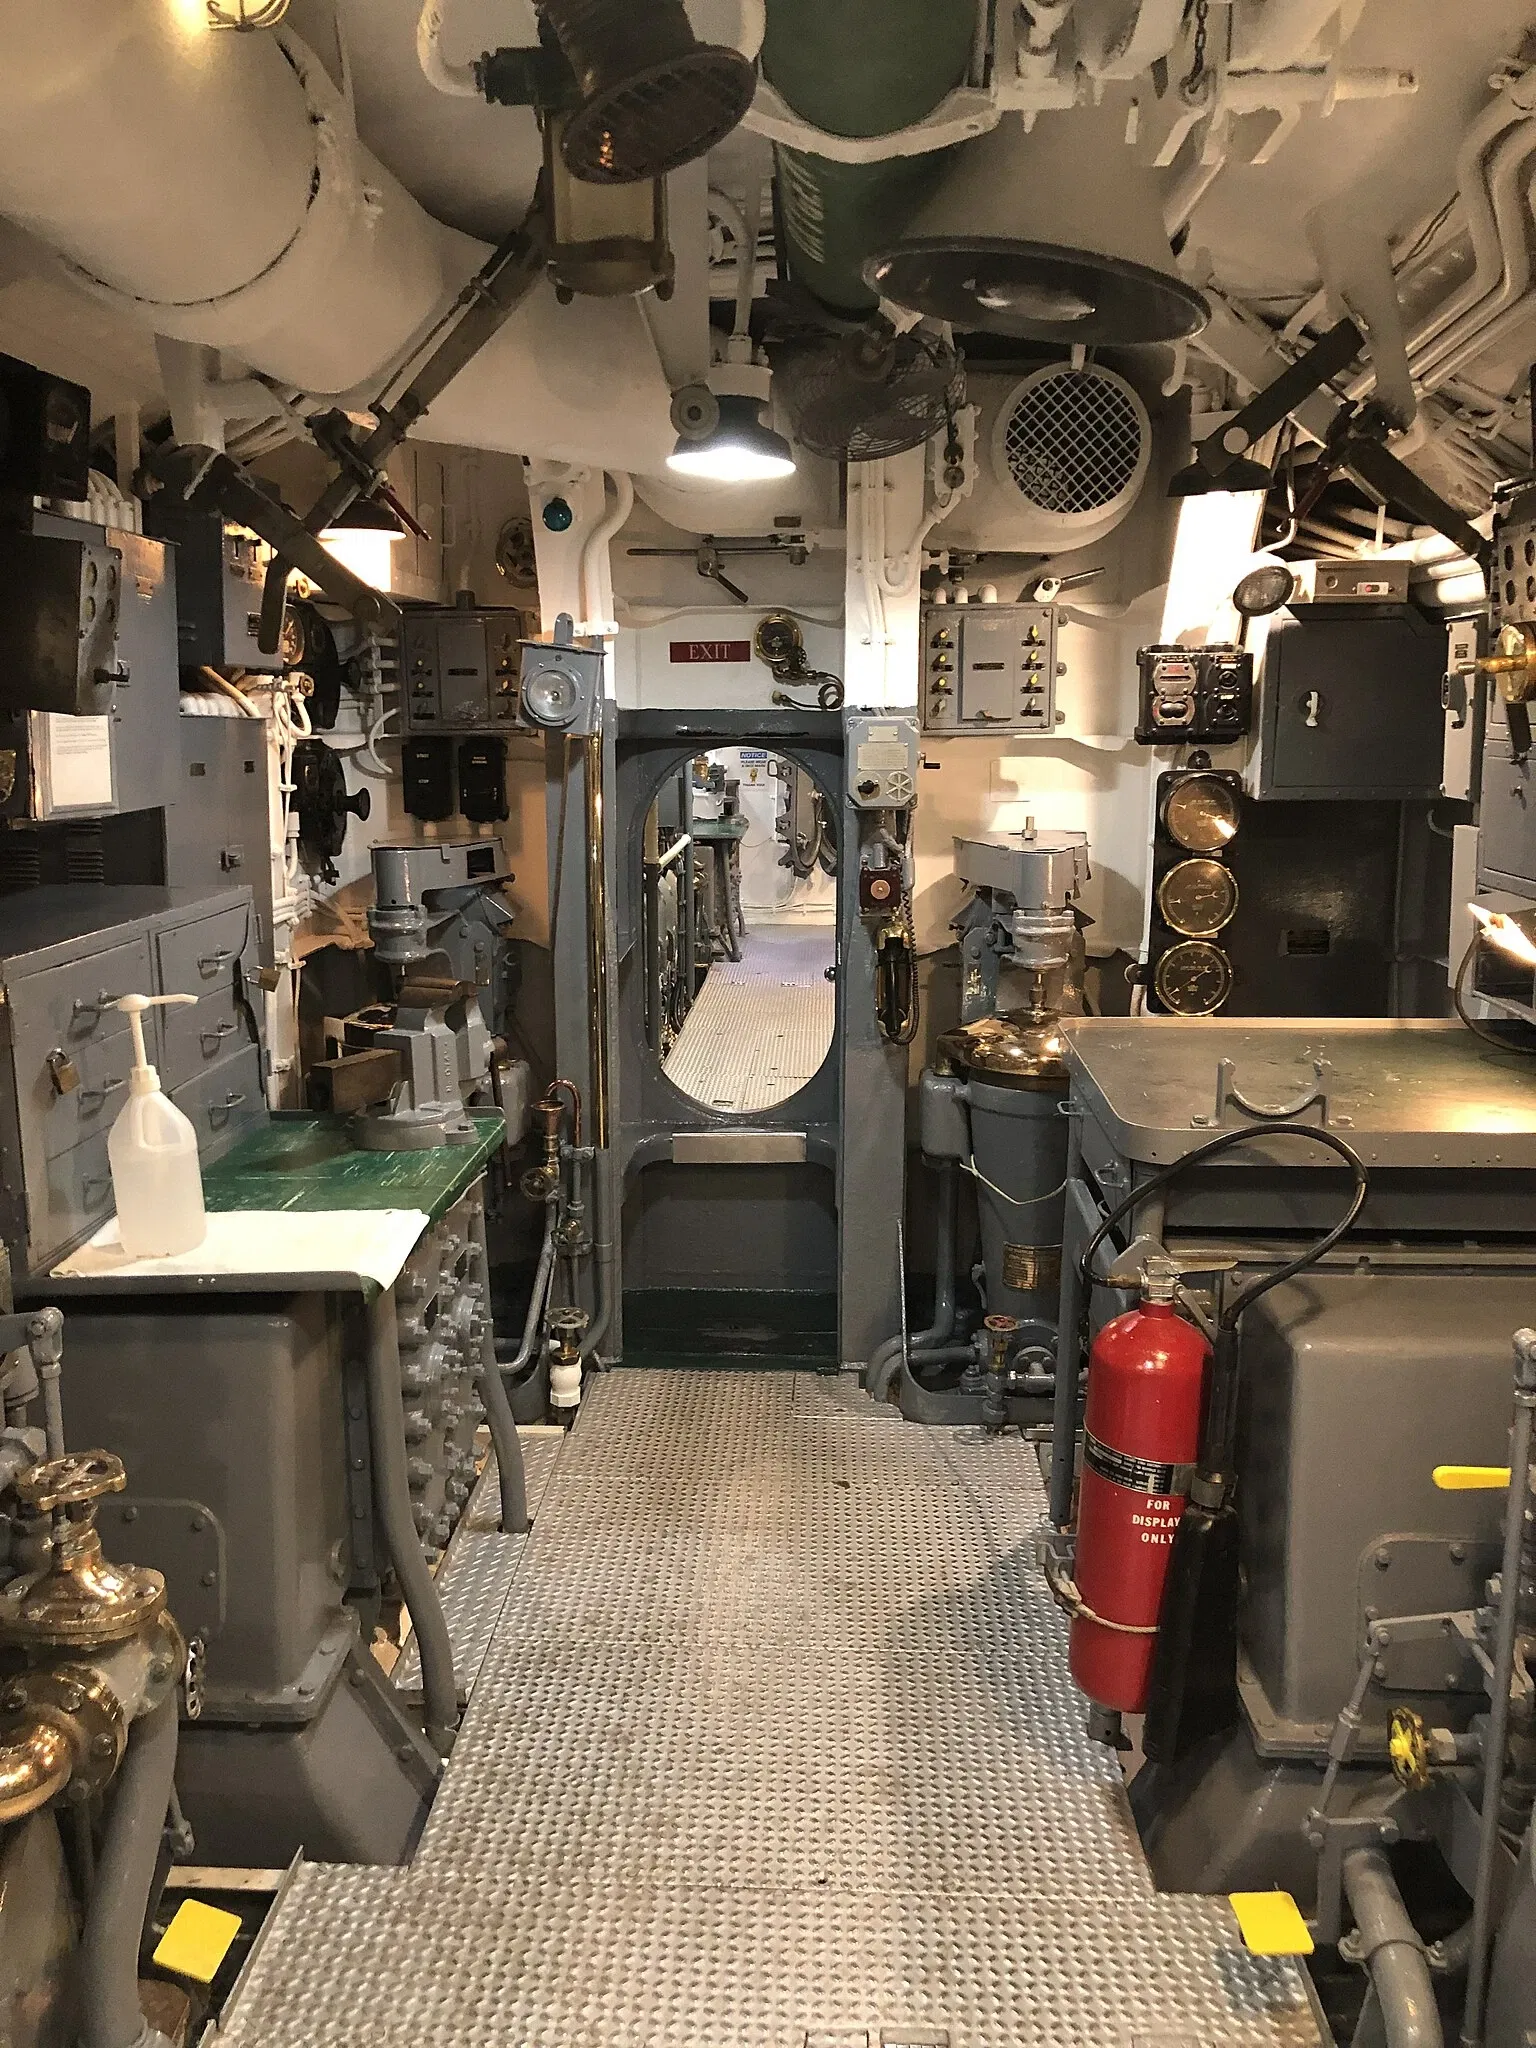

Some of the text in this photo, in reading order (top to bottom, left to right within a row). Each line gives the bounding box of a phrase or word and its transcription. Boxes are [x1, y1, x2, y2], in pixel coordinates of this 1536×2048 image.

[689, 643, 731, 660] EXIT
[1146, 1499, 1170, 1510] FOR
[1132, 1514, 1181, 1528] DISPLAY
[1141, 1532, 1175, 1544] ONLY
